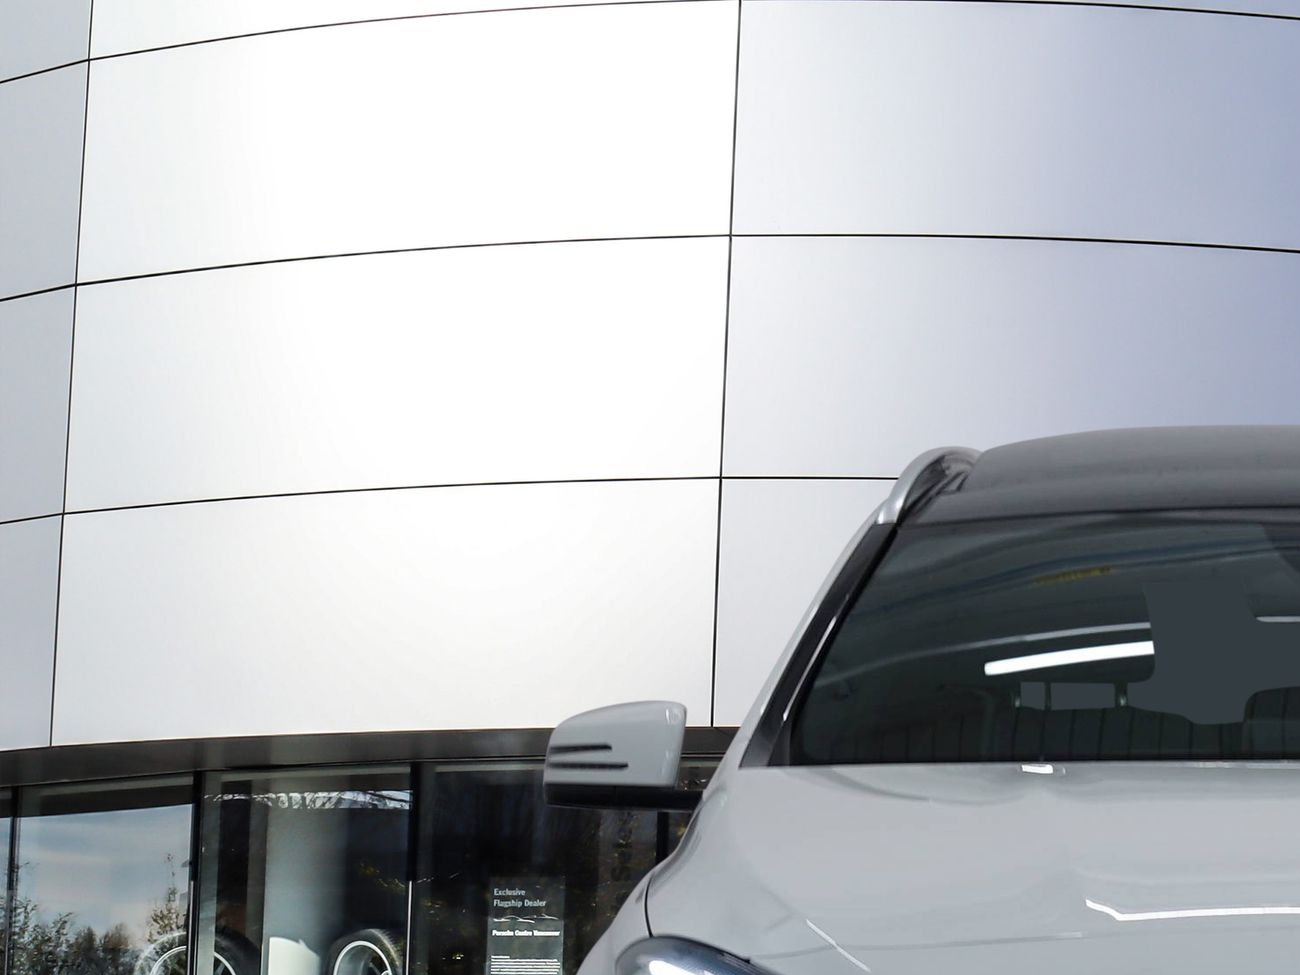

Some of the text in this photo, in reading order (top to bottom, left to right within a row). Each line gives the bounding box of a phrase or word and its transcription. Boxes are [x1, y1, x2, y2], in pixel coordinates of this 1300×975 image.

[493, 888, 526, 896] Exclusive
[493, 899, 547, 908] Flagship Dealer
